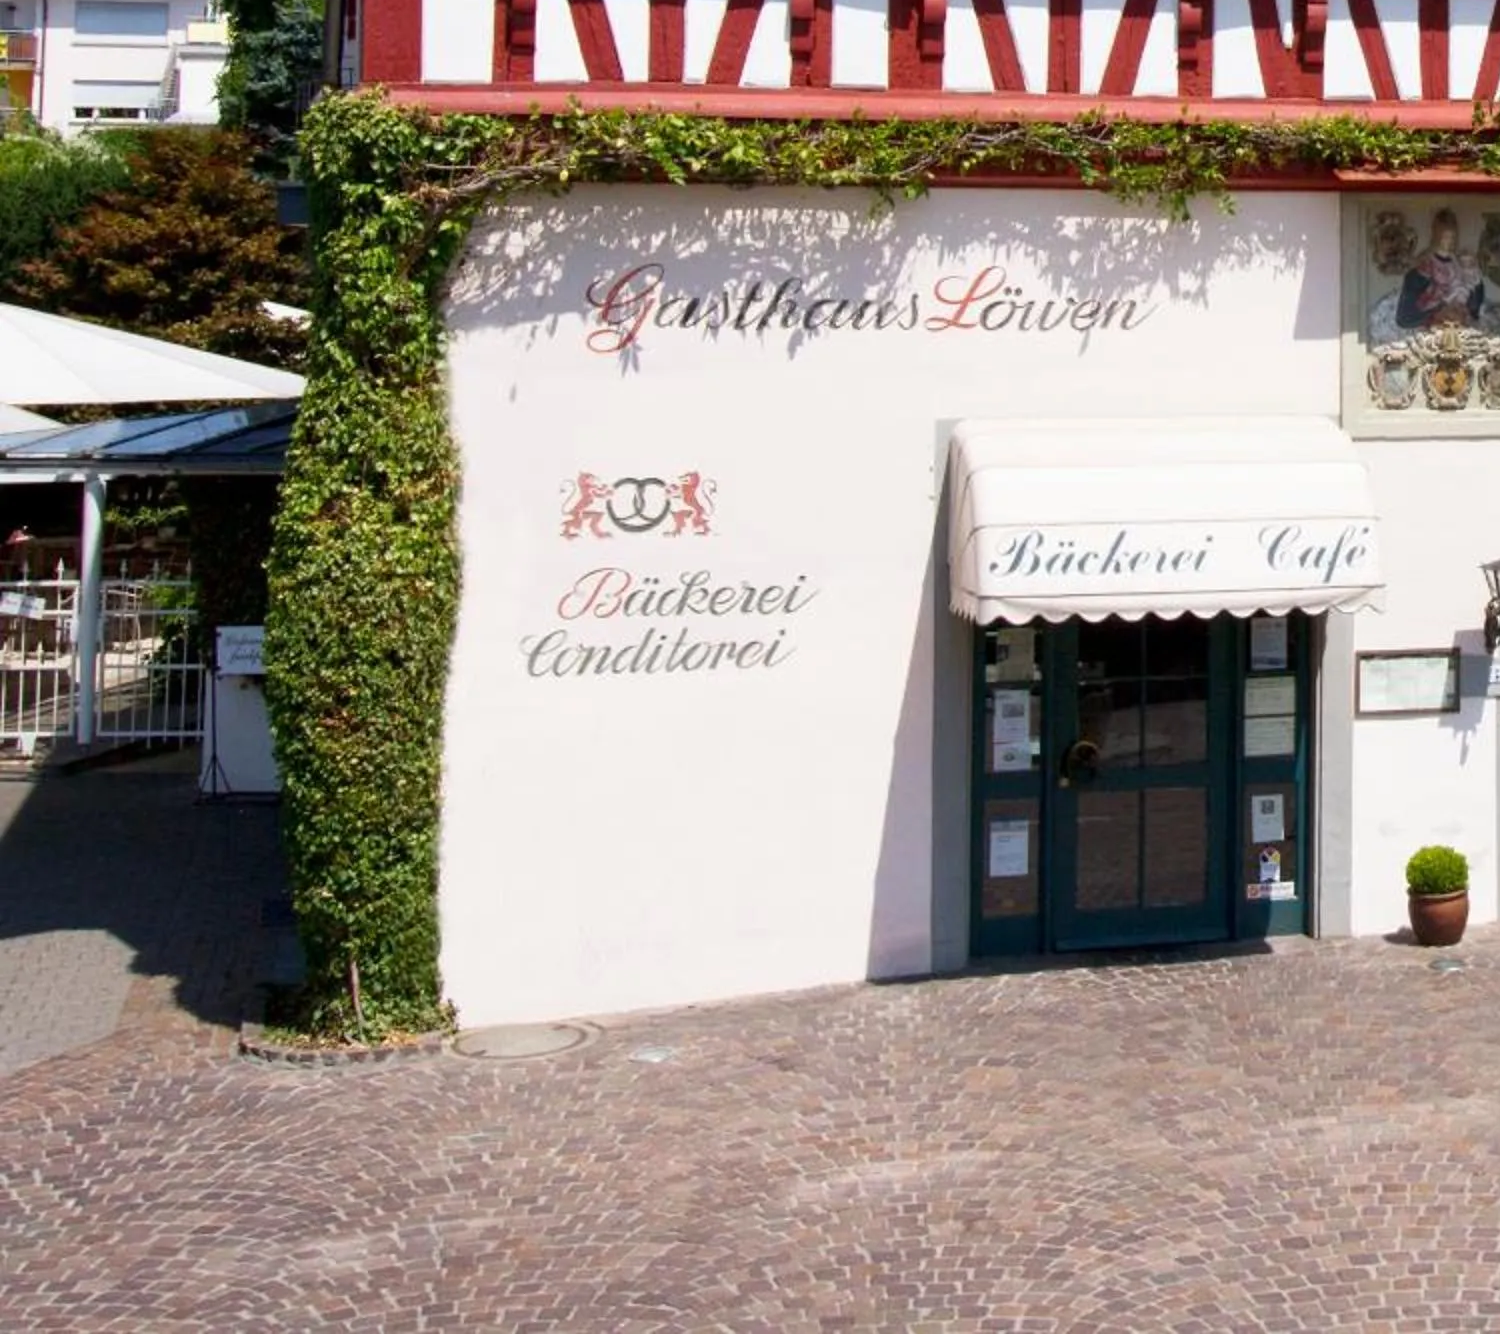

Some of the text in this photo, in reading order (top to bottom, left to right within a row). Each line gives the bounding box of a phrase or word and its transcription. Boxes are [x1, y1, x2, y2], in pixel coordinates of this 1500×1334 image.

[585, 263, 1157, 353] Gasthaus Löwen
[989, 526, 1371, 584] Bäckerei Café
[557, 567, 820, 620] Bäckerei
[519, 626, 797, 678] Conditorei
